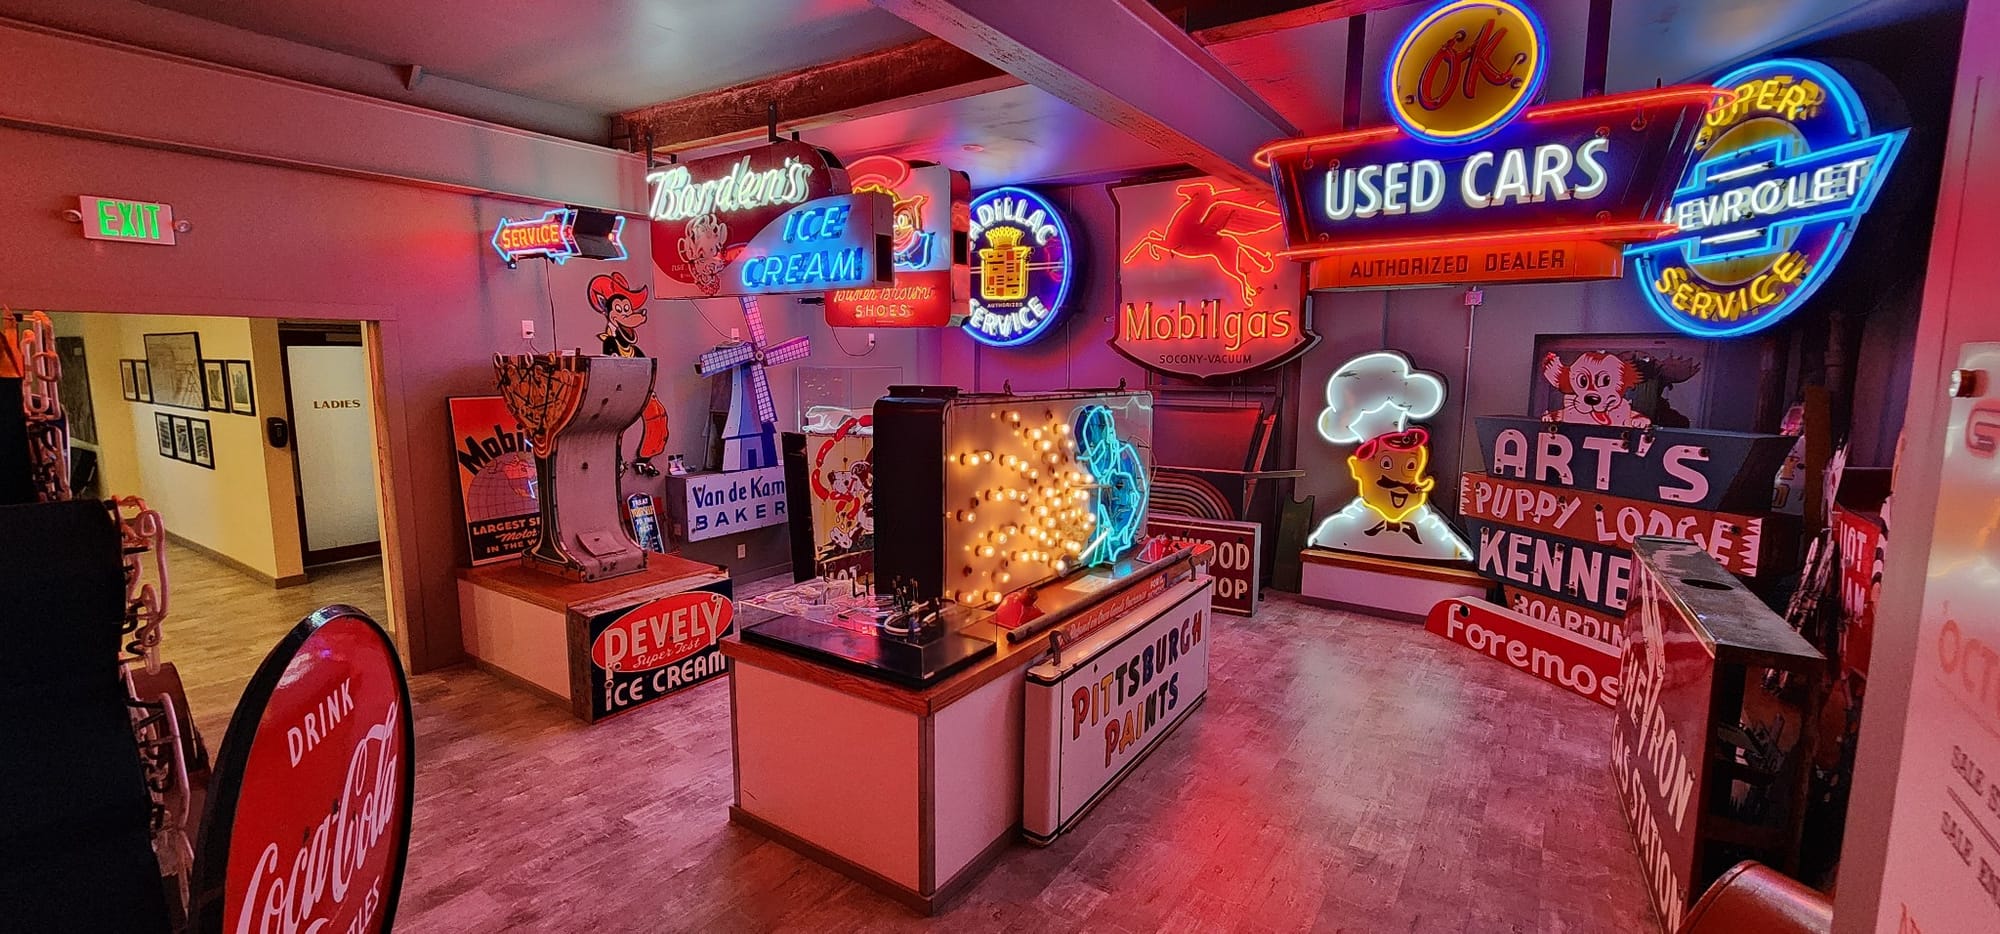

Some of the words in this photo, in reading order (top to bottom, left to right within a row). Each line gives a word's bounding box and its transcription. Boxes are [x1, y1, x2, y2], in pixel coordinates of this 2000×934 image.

[1419, 18, 1513, 111] OK
[647, 155, 814, 221] Borden's
[1325, 159, 1446, 220] USED
[1461, 138, 1610, 209] CARS
[1663, 155, 1878, 231] EVROLET
[97, 200, 160, 239] EXIT
[502, 224, 560, 249] SERVICE
[783, 204, 850, 243] ICE
[970, 197, 1058, 246] ADILLAC
[742, 247, 863, 287] CREAM
[1350, 254, 1468, 278] AUTHORIZED
[1485, 249, 1565, 272] DEALER
[1655, 251, 1813, 321] SERVICE
[855, 304, 910, 318] SHOES
[1126, 299, 1291, 351] Mobilgas
[1159, 354, 1252, 364] SOCONY-VACUUM
[313, 399, 361, 409] LADIES
[1494, 428, 1710, 503] ART'S
[692, 484, 724, 508] Van
[729, 481, 747, 502] de
[695, 501, 786, 531] BAKER
[473, 519, 526, 535] LARGEST
[486, 545, 499, 553] IN
[504, 541, 524, 551] THE
[496, 529, 537, 543] Motor
[1475, 481, 1581, 529] PUPPY
[1595, 501, 1733, 566] LODGE
[604, 597, 723, 680] DEVELY
[633, 648, 673, 668] Super
[604, 677, 643, 711] ICE
[653, 650, 725, 692] CREAM
[1072, 609, 1202, 741] PITTSBURGH
[287, 678, 354, 768] DRINK
[1105, 672, 1179, 768] PAINTS
[1619, 610, 1695, 833] CHEVRON
[1612, 713, 1631, 794] GAS
[1951, 744, 1985, 796] SALE
[236, 694, 399, 934] Coca-Cola
[1941, 810, 1975, 867] SALE
[1631, 767, 1682, 934] STATION
